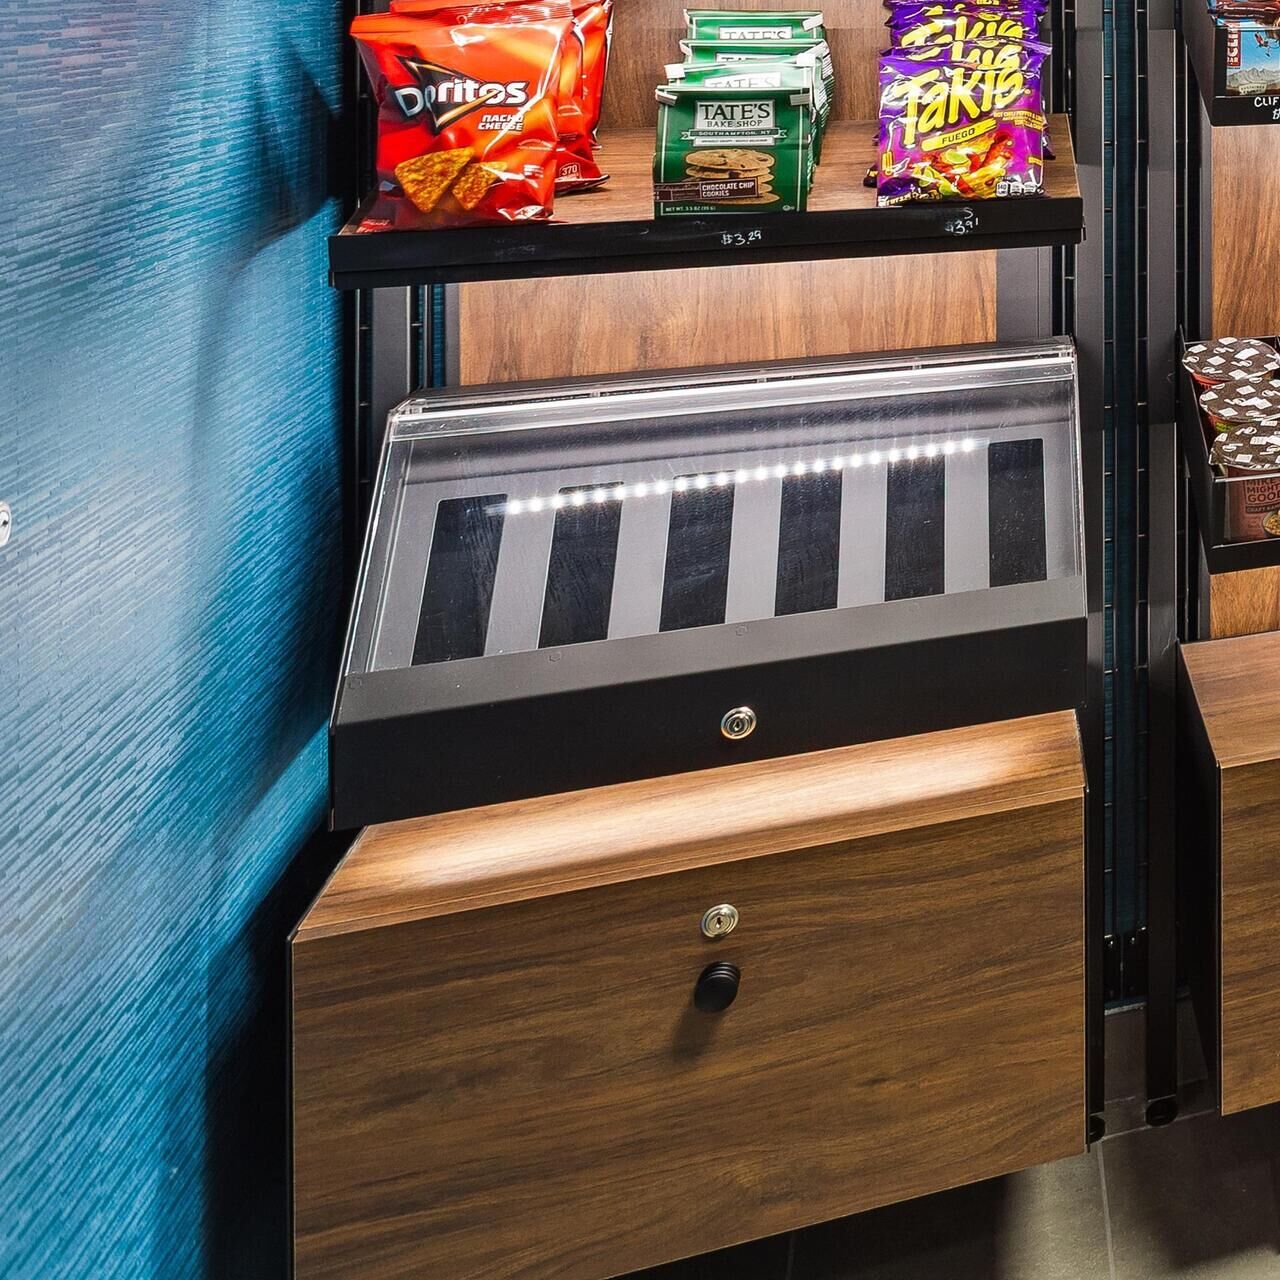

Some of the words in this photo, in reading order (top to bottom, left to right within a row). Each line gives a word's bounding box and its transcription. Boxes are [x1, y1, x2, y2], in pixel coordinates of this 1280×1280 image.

[395, 79, 529, 117] Doritos
[482, 114, 525, 123] NACHO
[700, 103, 770, 120] TATE'S
[942, 127, 975, 145] FUEGO
[562, 164, 578, 175] 370
[702, 183, 738, 191] CHOCOLATE
[721, 230, 762, 245] $3.29
